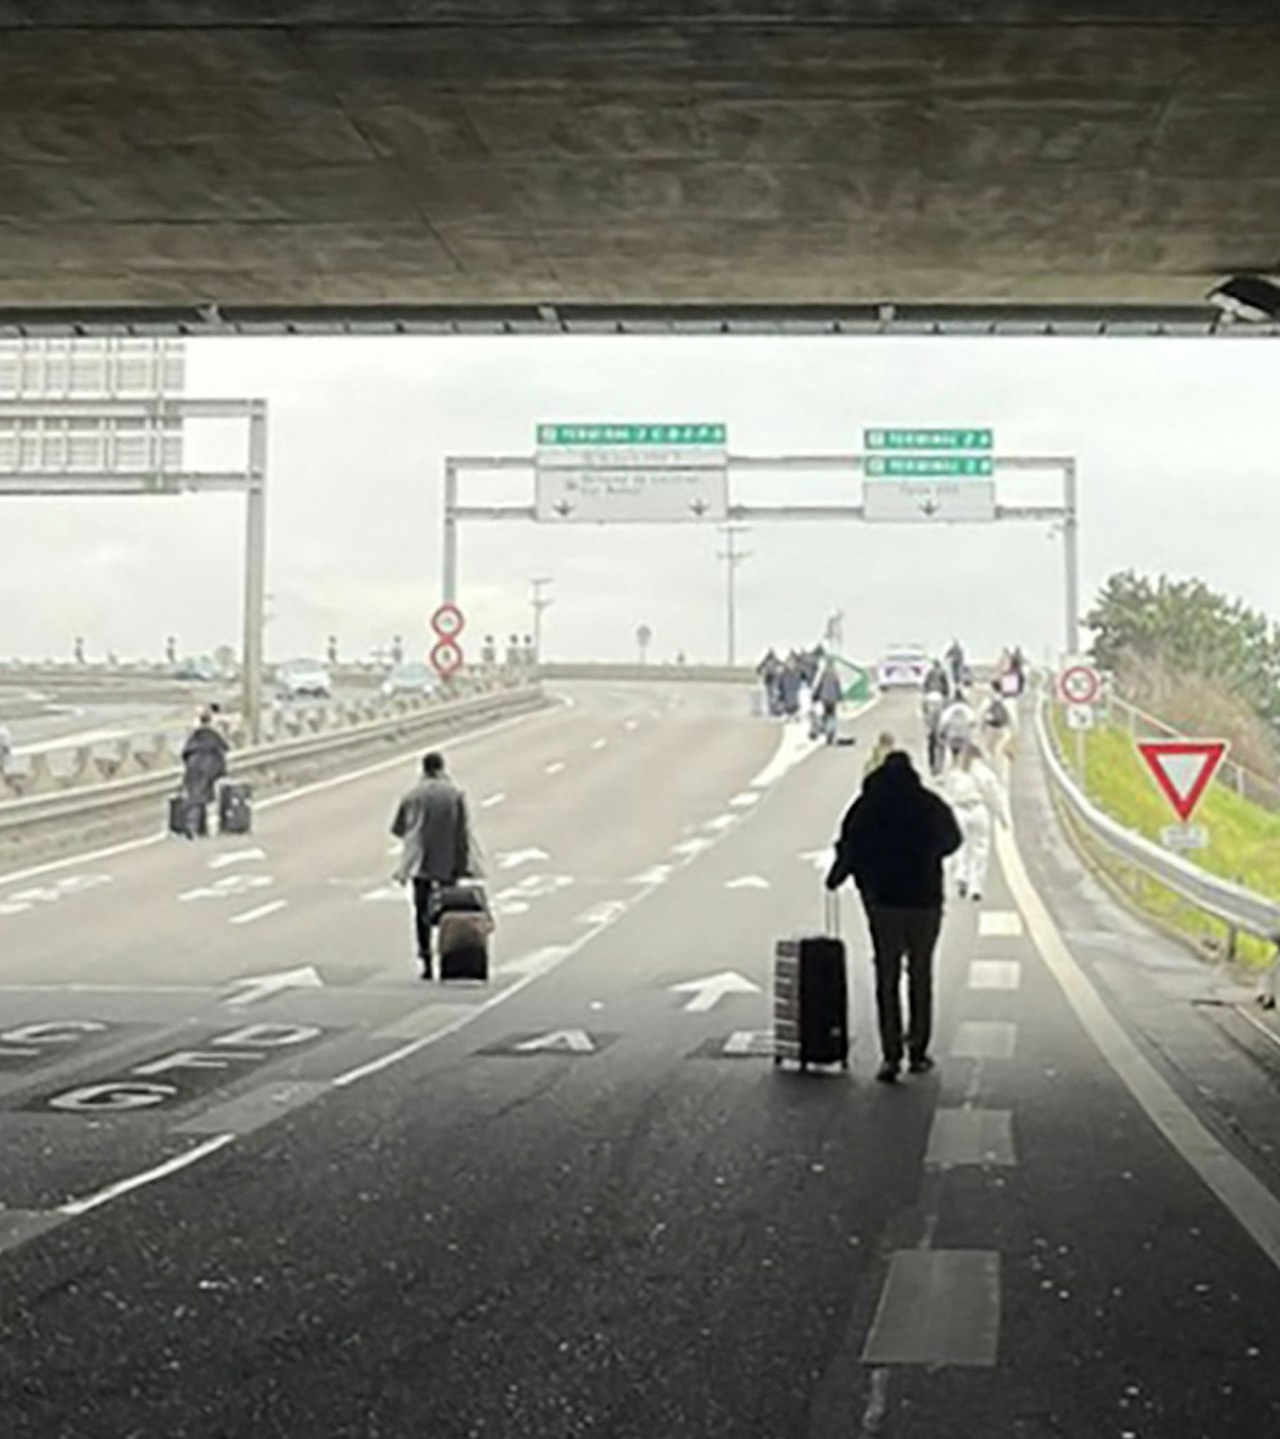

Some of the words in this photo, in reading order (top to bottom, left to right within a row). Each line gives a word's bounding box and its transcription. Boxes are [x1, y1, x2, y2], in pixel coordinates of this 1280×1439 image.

[0, 1019, 108, 1043] C
[211, 1022, 324, 1048] D
[513, 1029, 596, 1052] A
[130, 1050, 268, 1076] F
[48, 1081, 178, 1111] G
